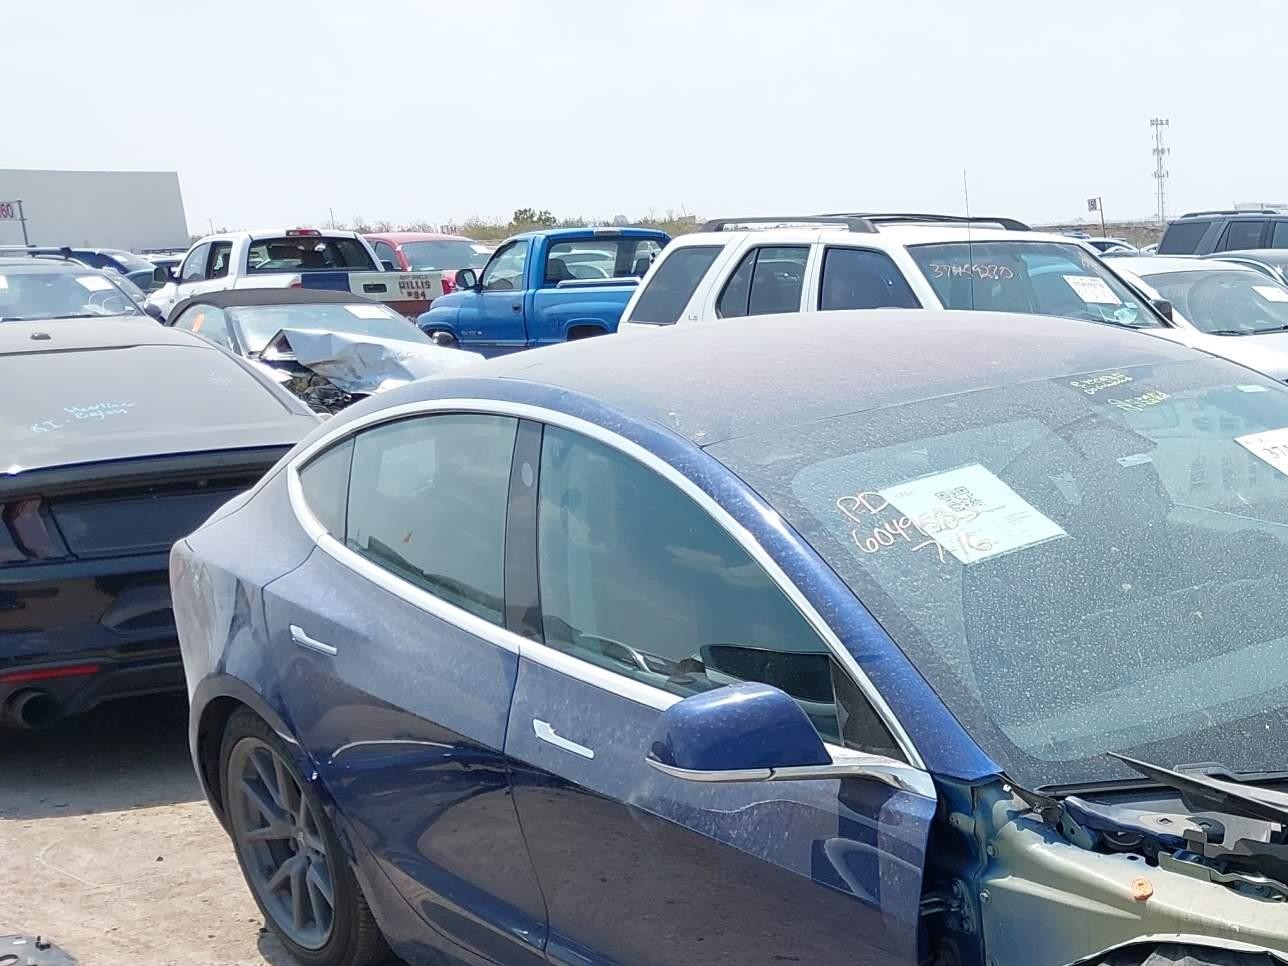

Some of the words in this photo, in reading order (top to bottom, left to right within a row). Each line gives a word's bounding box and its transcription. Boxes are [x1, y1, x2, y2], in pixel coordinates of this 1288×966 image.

[0, 203, 14, 218] 60
[399, 280, 431, 289] WILLIS
[836, 491, 889, 523] PD
